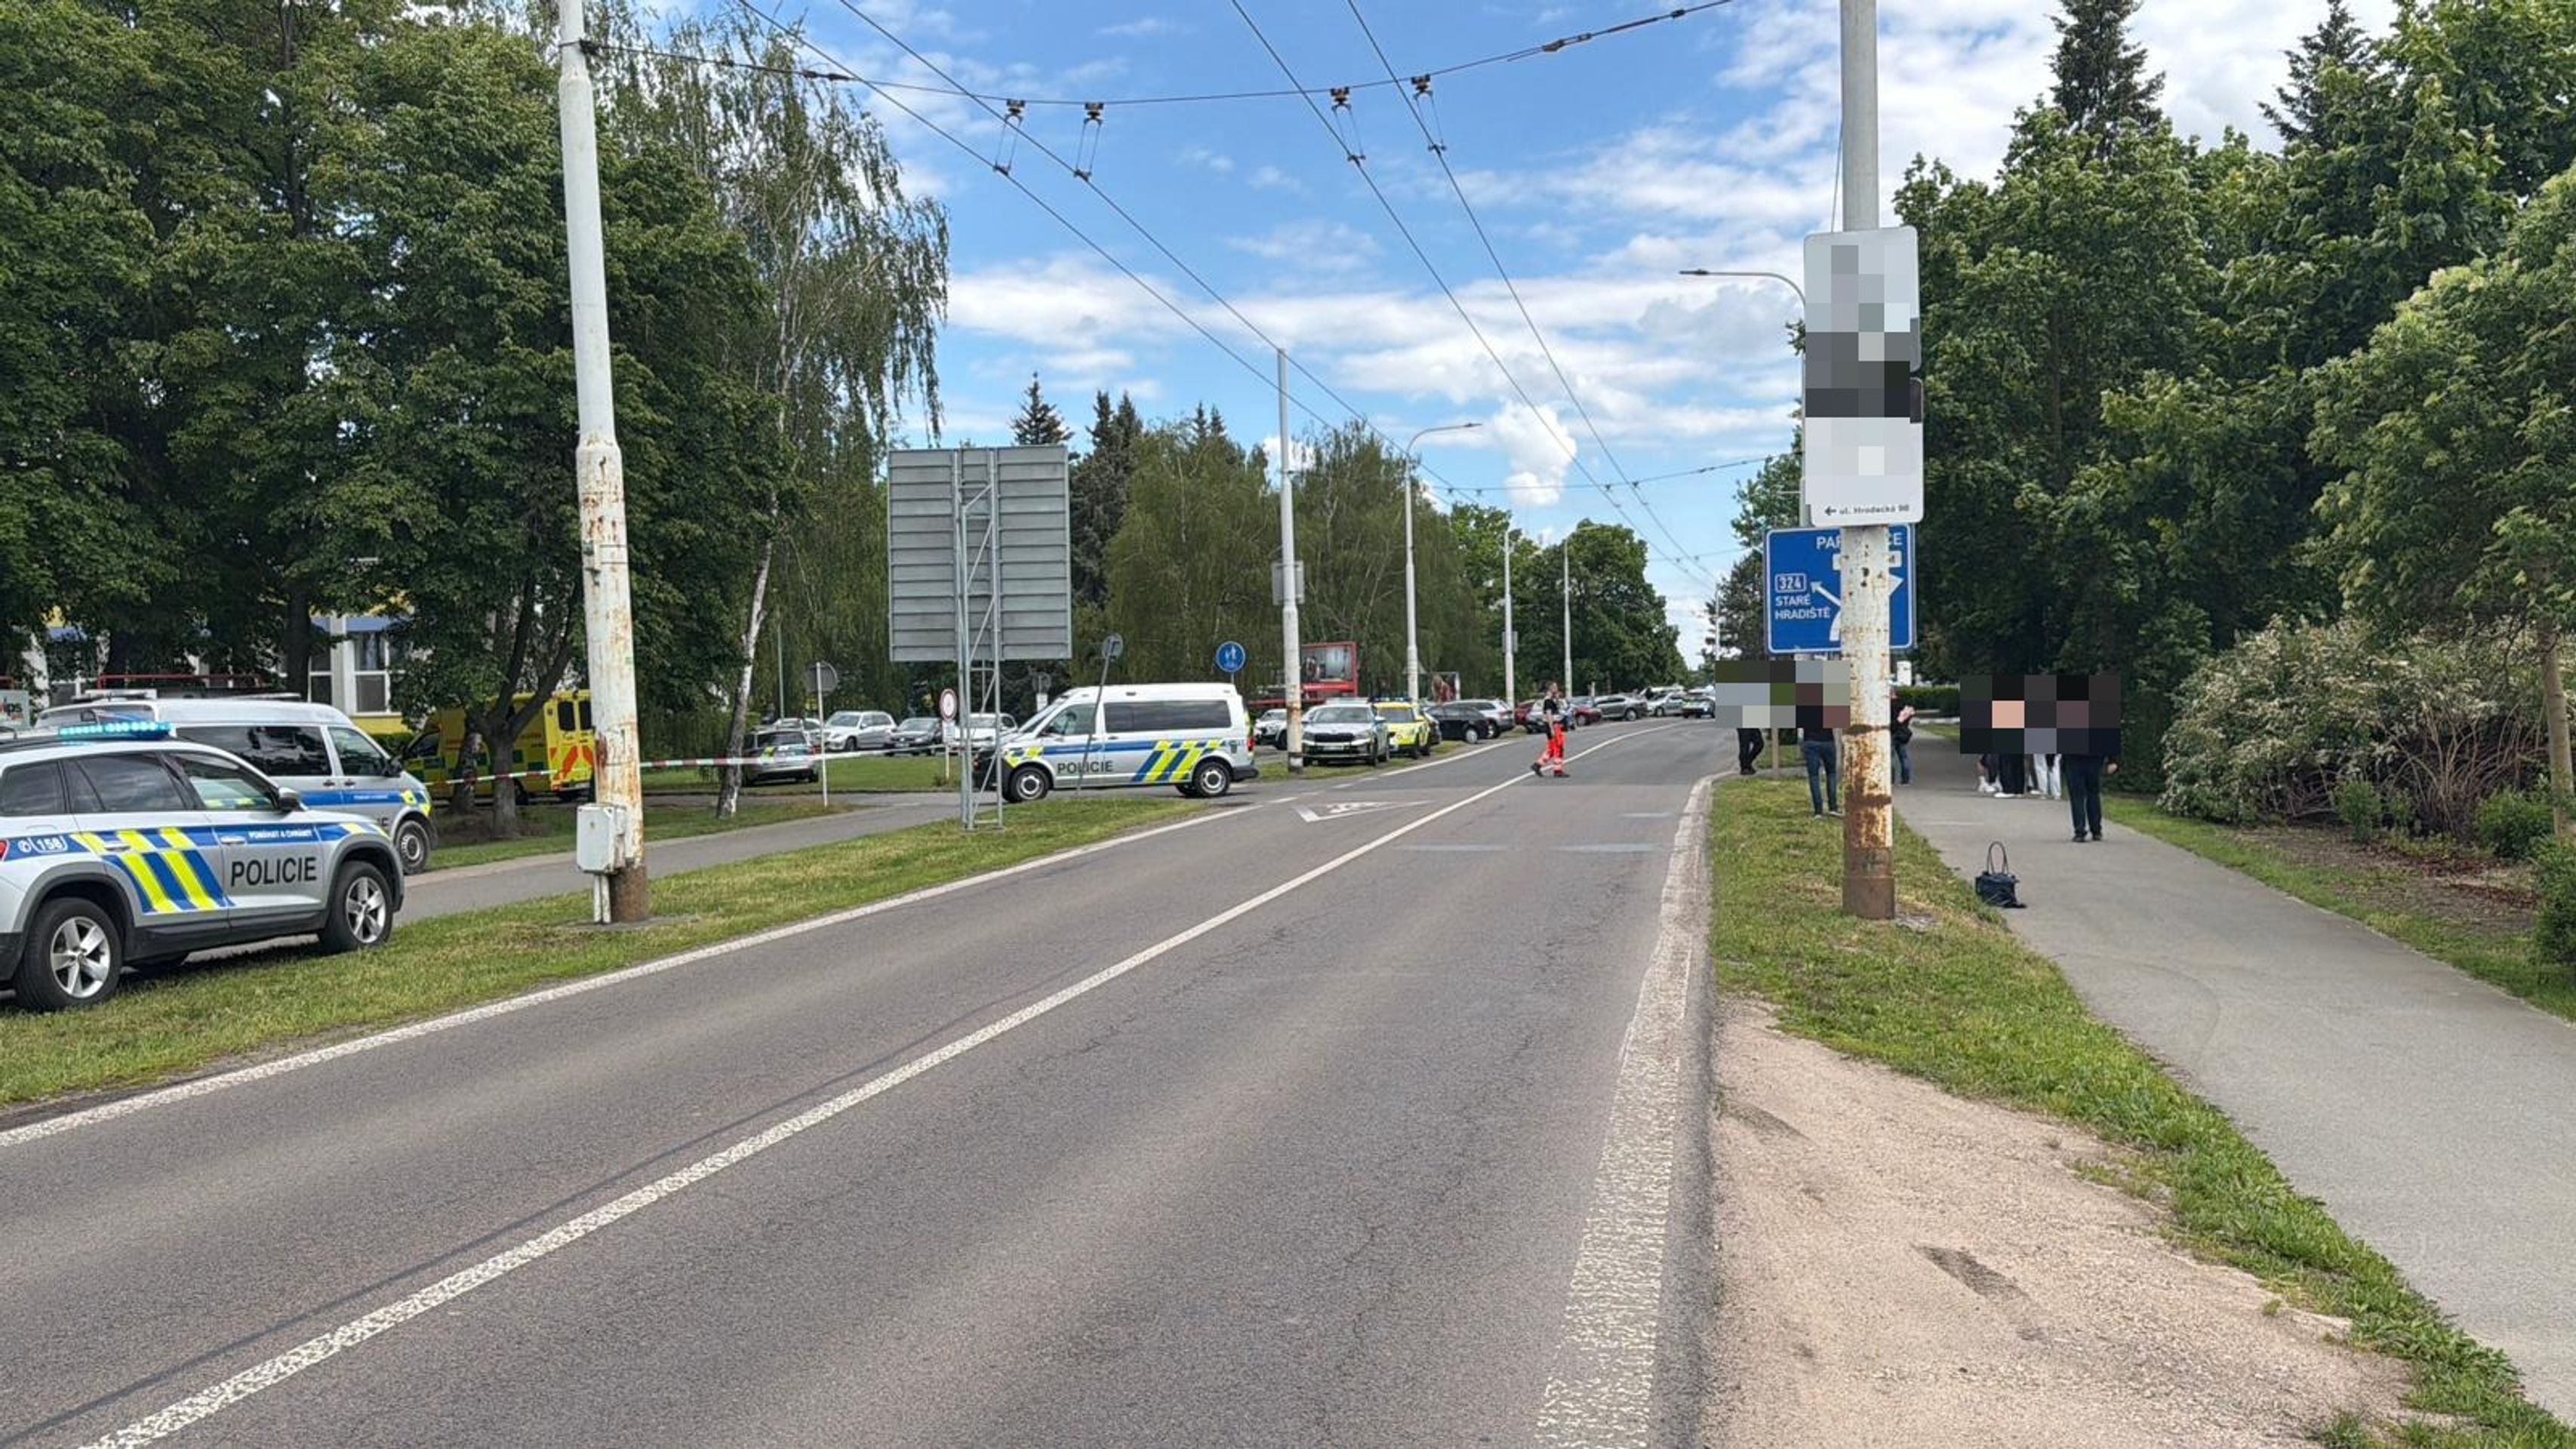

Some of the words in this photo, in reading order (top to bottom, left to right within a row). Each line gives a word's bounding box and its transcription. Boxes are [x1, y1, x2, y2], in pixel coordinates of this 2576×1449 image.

[1779, 576, 1802, 589] 324
[1775, 593, 1811, 606] STARÉ
[1057, 760, 1113, 774] POLICIE
[37, 837, 63, 851] 158
[230, 856, 317, 888] POLICIE
